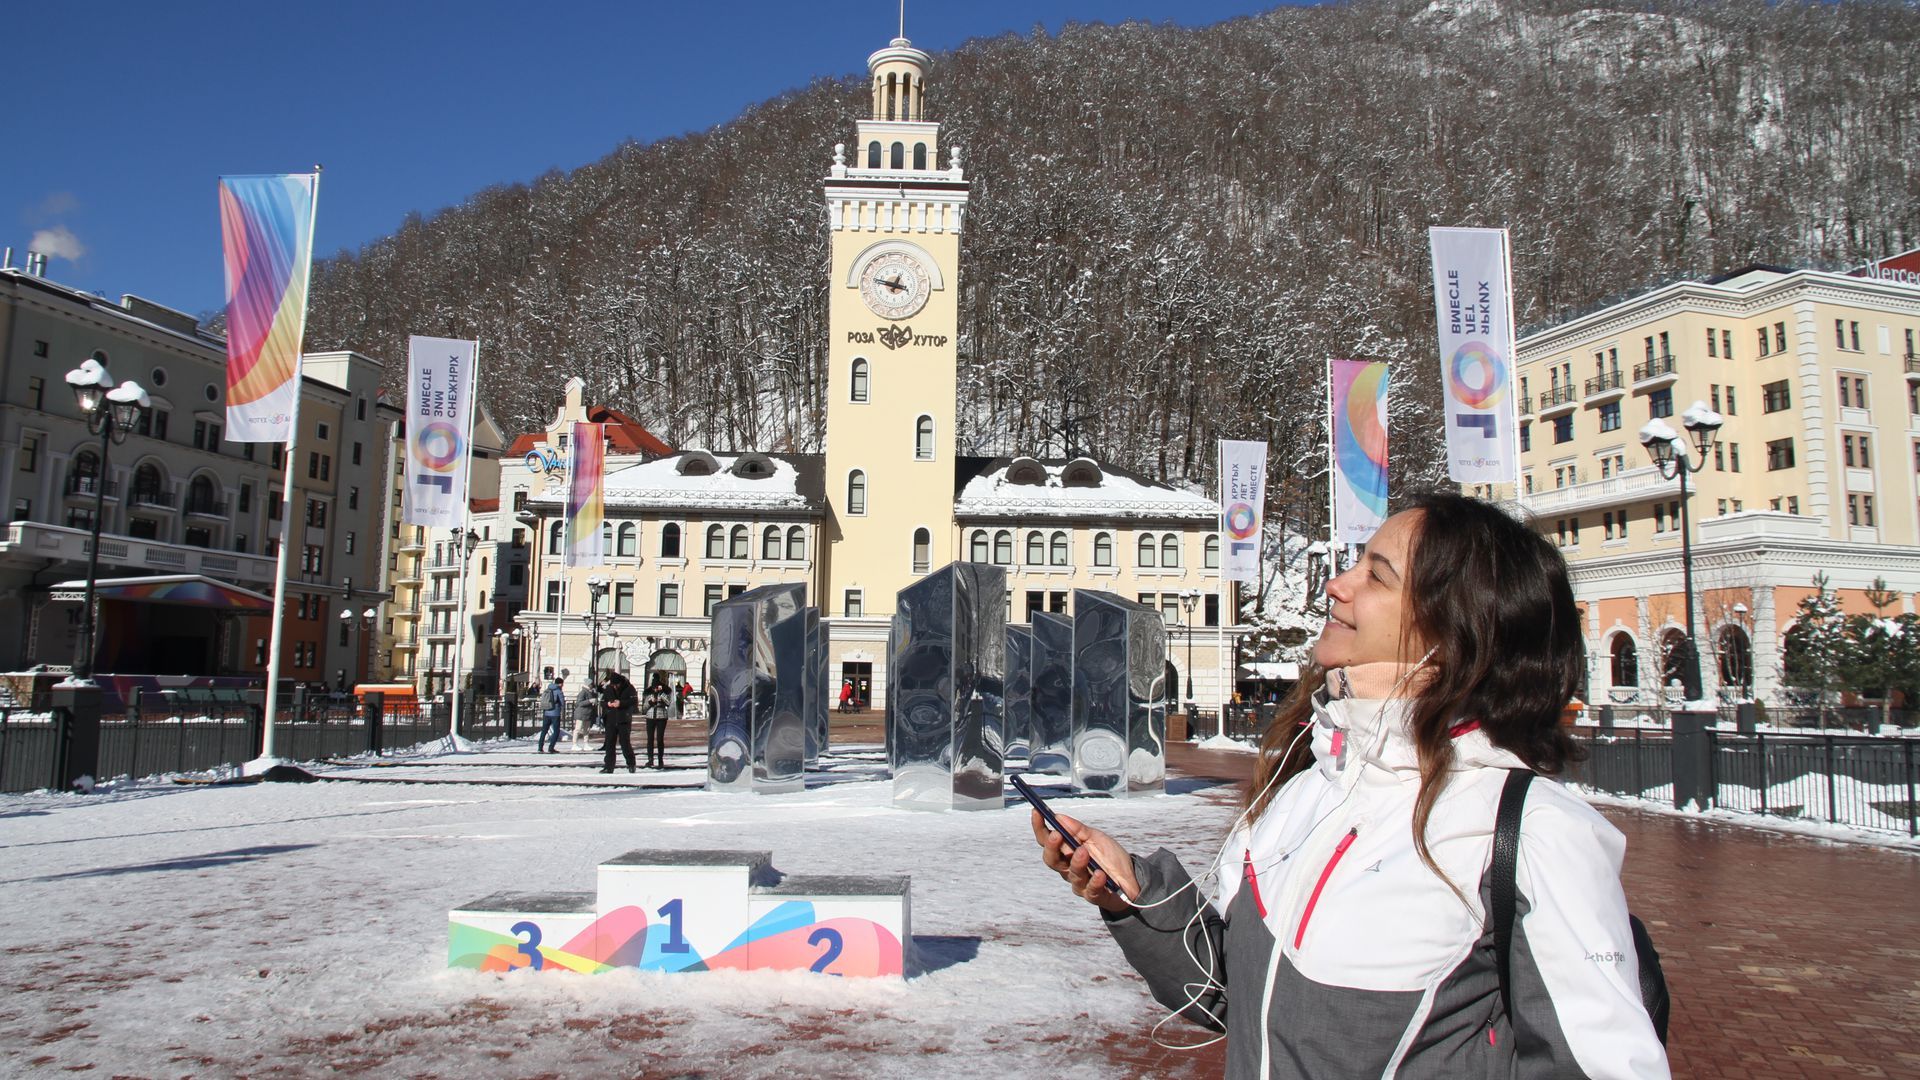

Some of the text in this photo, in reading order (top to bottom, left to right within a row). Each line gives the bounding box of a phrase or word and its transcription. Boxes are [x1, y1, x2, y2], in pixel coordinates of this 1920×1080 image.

[847, 331, 948, 347] РОЗА ХУТОР
[1231, 463, 1239, 500] КРУТЫХ
[1240, 483, 1248, 500] ЛЕТ
[1250, 464, 1258, 500] ВМЕСТЕ
[657, 898, 690, 954] 1
[508, 921, 544, 971] 3
[807, 927, 843, 977] 2
